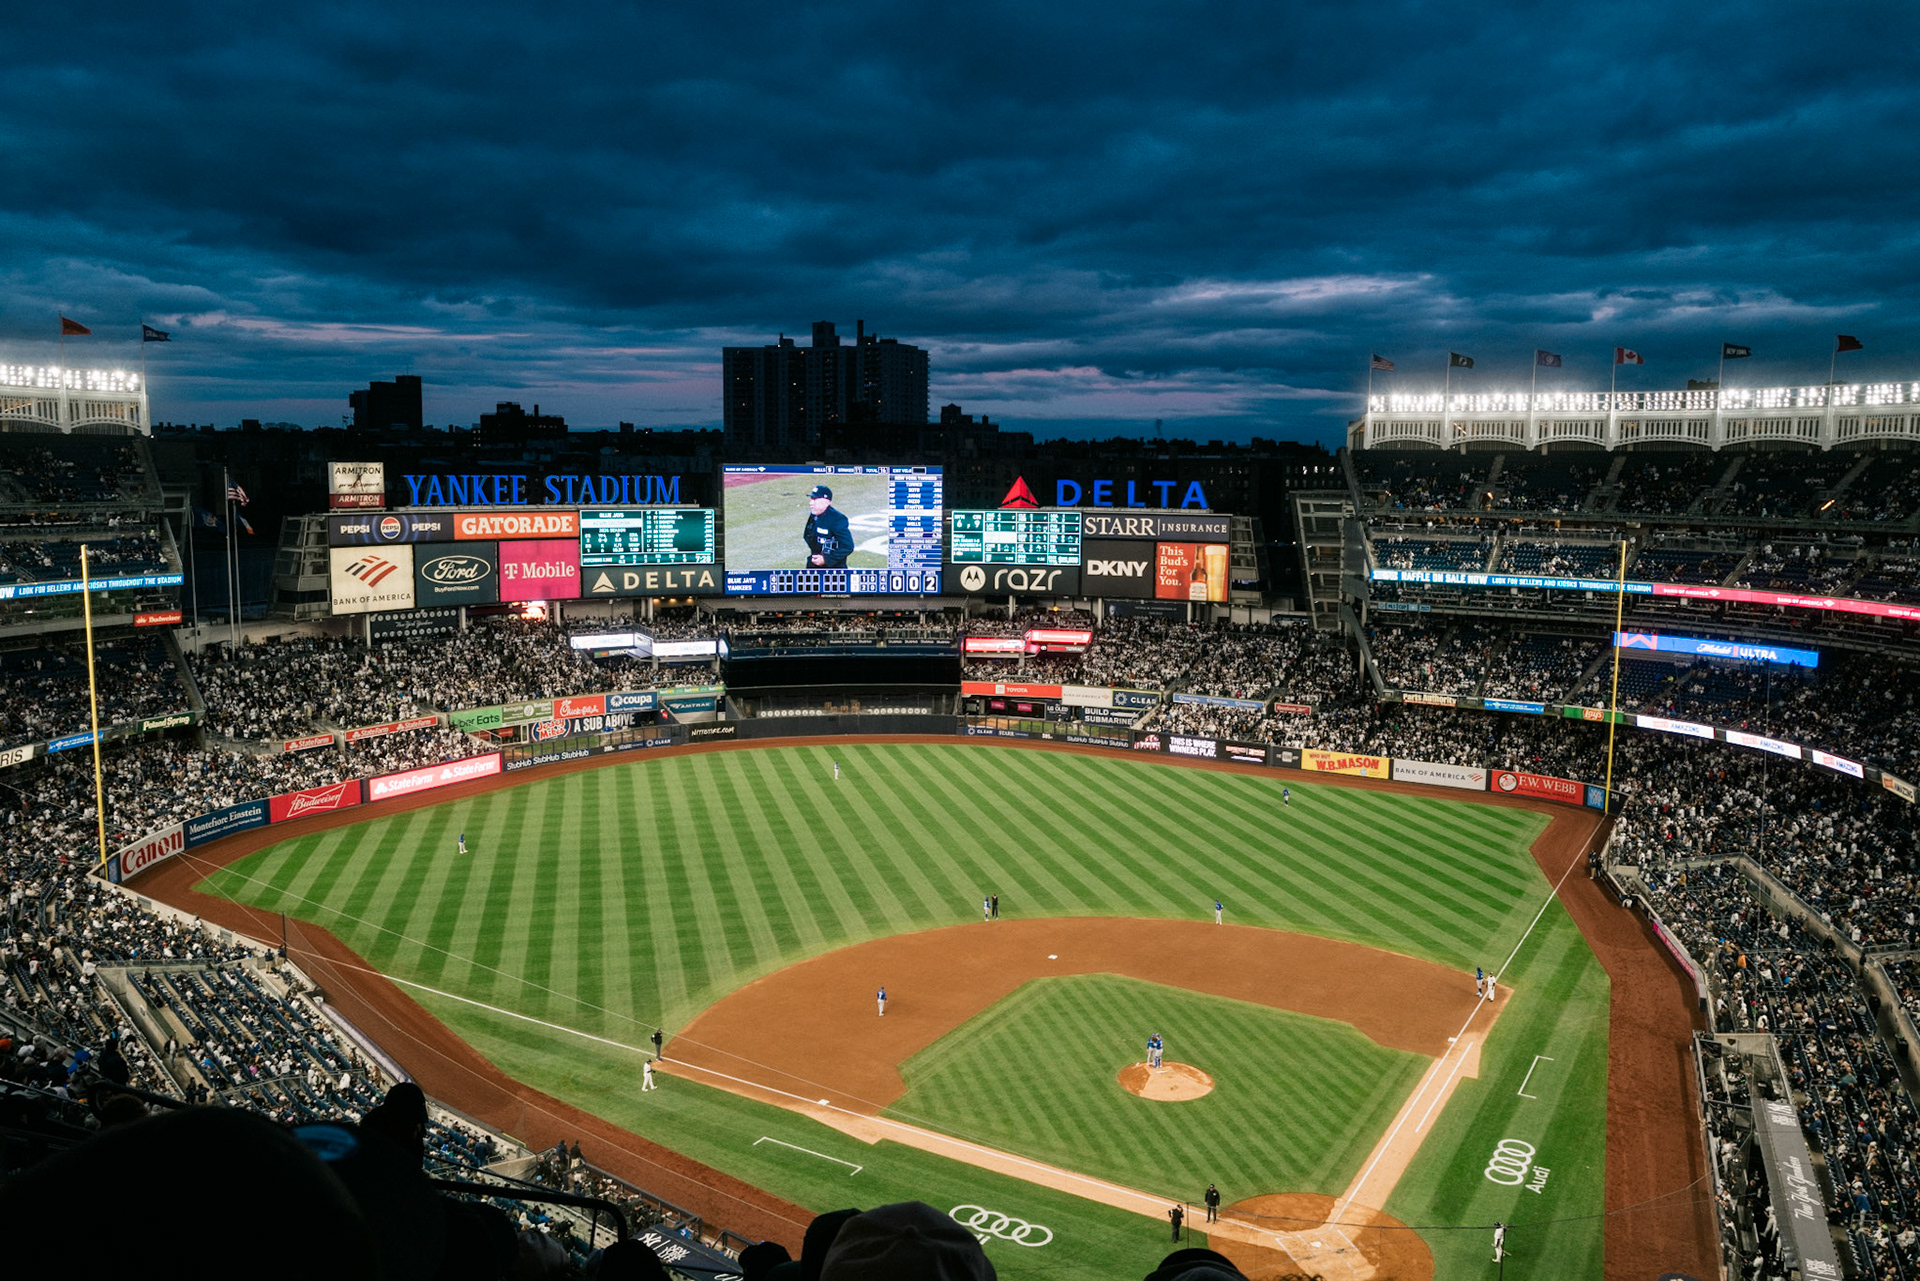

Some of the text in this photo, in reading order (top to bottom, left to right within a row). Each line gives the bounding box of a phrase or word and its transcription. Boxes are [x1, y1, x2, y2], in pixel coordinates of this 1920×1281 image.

[402, 474, 681, 506] YANKEE STADIUM
[1057, 480, 1209, 508] DELTA
[340, 525, 370, 534] PEPSI
[412, 523, 441, 532] PEPSI
[462, 515, 573, 535] GATORADE
[1084, 517, 1227, 536] STARR INSURANCE
[1160, 545, 1184, 556] This
[1087, 560, 1148, 577] DKNY
[1160, 556, 1188, 566] Bud's
[434, 559, 477, 580] Ford
[522, 561, 575, 579] Mobile
[1160, 566, 1177, 575] For
[19, 587, 33, 595] LOOK
[46, 584, 71, 592] SELLERS
[73, 582, 85, 590] AND
[109, 578, 143, 588] THROUGHOUT
[145, 577, 156, 585] THE
[157, 575, 182, 584] STADIUM
[624, 570, 715, 590] DELTA
[893, 577, 935, 590] 0 0 2
[994, 569, 1062, 591] razr
[1159, 576, 1181, 586] You.
[1401, 571, 1430, 582] RAFFLE
[1432, 573, 1444, 583] ON
[1445, 574, 1466, 584] SALE
[1467, 575, 1489, 585] NOW
[1579, 582, 1613, 590] THROUGHOUT
[1627, 584, 1652, 592] STADIUM
[333, 598, 357, 606] BANK
[372, 593, 411, 602] AMERICA
[148, 615, 181, 623] Budweiser
[1741, 648, 1777, 659] ULTRA
[623, 695, 652, 705] coupa
[1130, 696, 1157, 704] CLEAR
[1402, 693, 1457, 705] Parts Authority
[143, 716, 190, 731] Poland Spring
[477, 714, 500, 725] Eats
[537, 719, 566, 731] Jersey
[574, 713, 636, 733] A SUB ABOVE
[692, 726, 735, 736] NITTOTIRE.COM
[1088, 737, 1109, 745] StubHub
[1109, 739, 1128, 747] StubHub
[1170, 737, 1184, 745] THIS
[1192, 739, 1217, 748] WHERE
[0, 749, 23, 766] RIS
[1169, 744, 1199, 755] WINNERS
[1200, 747, 1217, 757] PLAY.
[506, 749, 589, 770] StubHub StubHub StubHub
[1429, 771, 1466, 780] AMERICA
[1519, 775, 1540, 788] F.W.
[1543, 780, 1576, 794] WEBB
[292, 793, 340, 810] Budweiser
[189, 816, 228, 835] Montefiore
[229, 807, 262, 822] Einstein
[122, 831, 182, 875] Canon
[1783, 1156, 1816, 1187] Yankees
[1525, 1165, 1551, 1194] Audi
[1794, 1206, 1815, 1220] New
